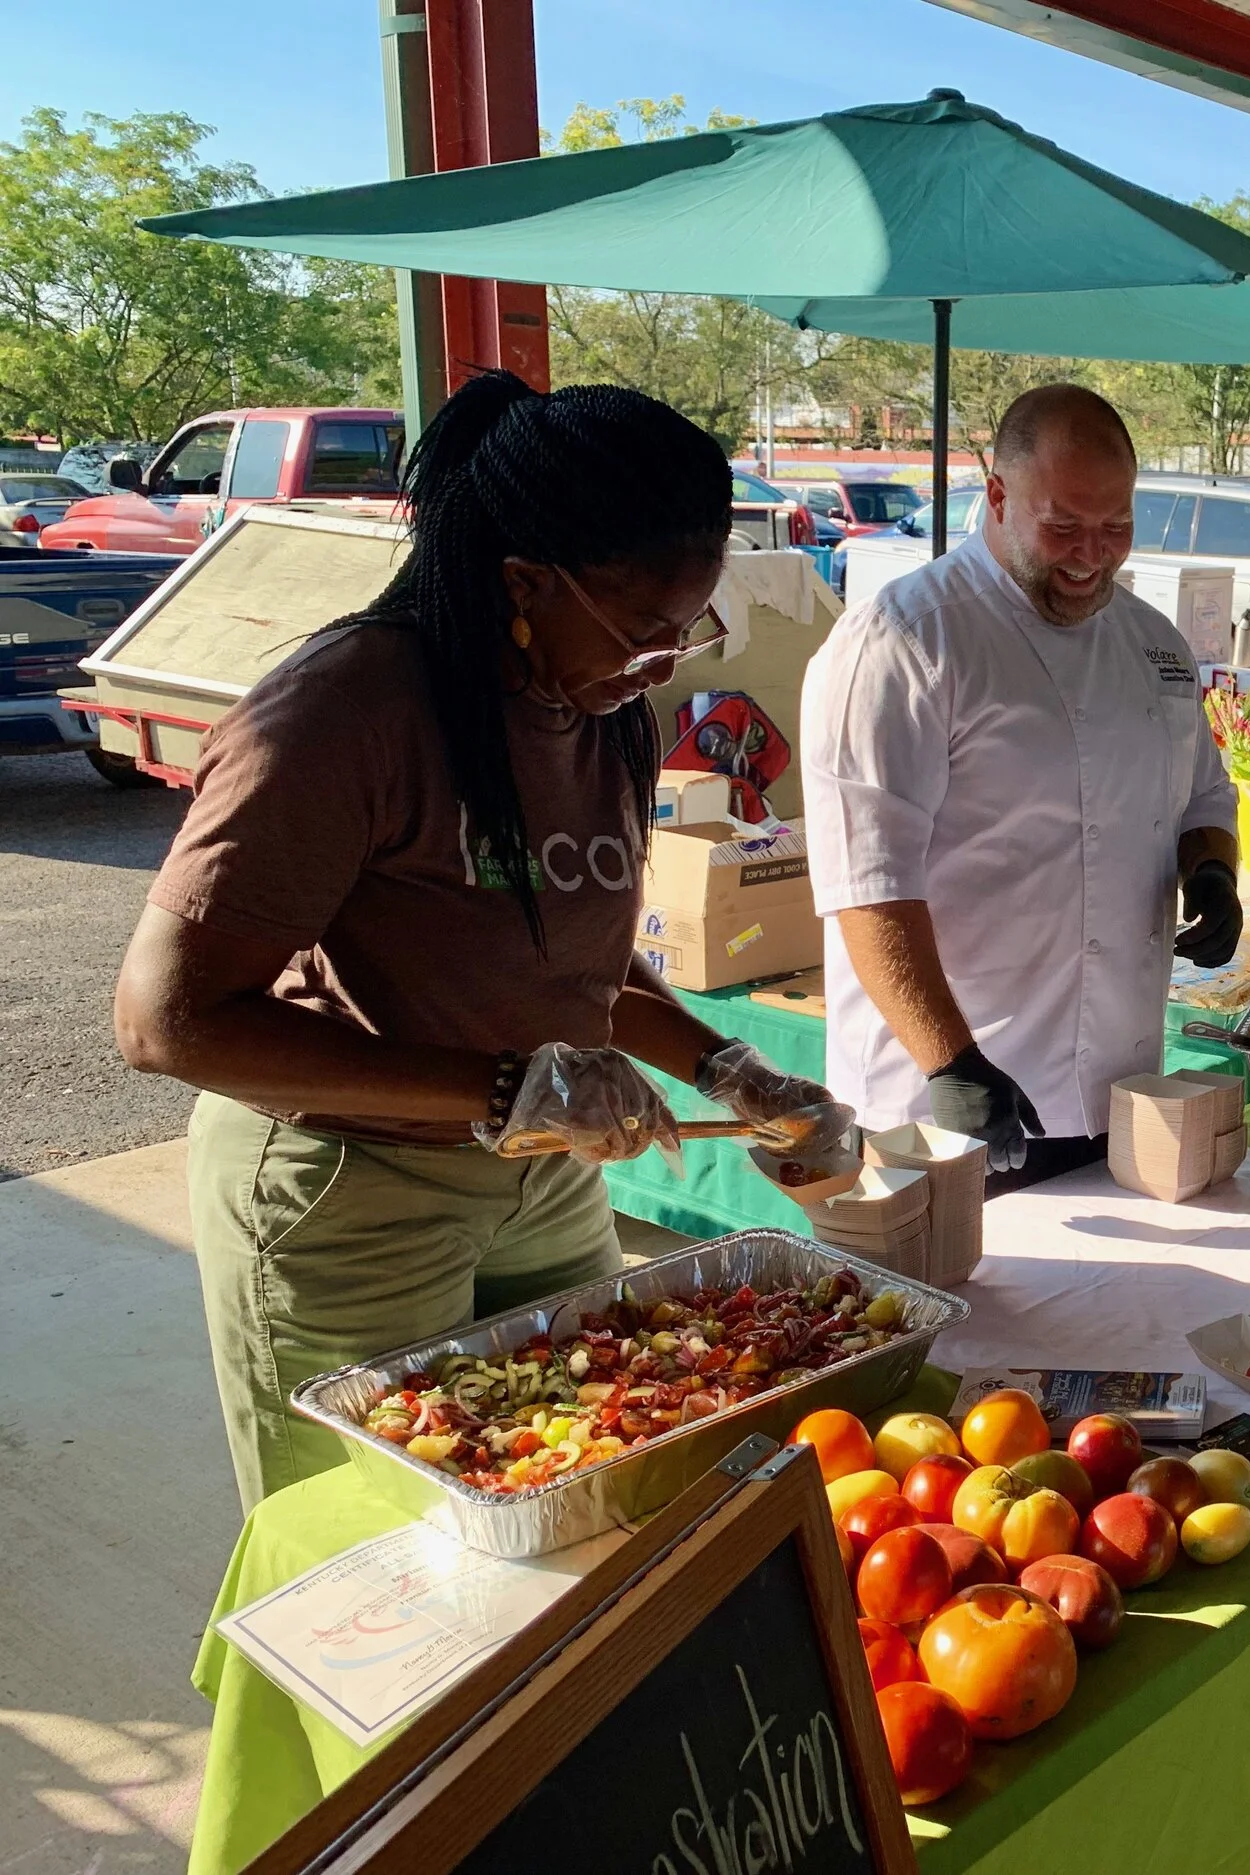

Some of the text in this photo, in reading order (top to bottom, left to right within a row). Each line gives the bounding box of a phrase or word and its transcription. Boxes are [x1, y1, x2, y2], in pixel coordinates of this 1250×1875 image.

[1143, 647, 1178, 661] Volare
[459, 800, 647, 892] lca
[744, 868, 767, 880] PLACE
[768, 866, 781, 876] DRY
[783, 863, 800, 873] COOL
[487, 873, 538, 887] MAT
[294, 1534, 413, 1596] KENTUCKY DEPARTME
[331, 1545, 404, 1584] CERTIFICATE
[652, 1664, 864, 1875] stration
